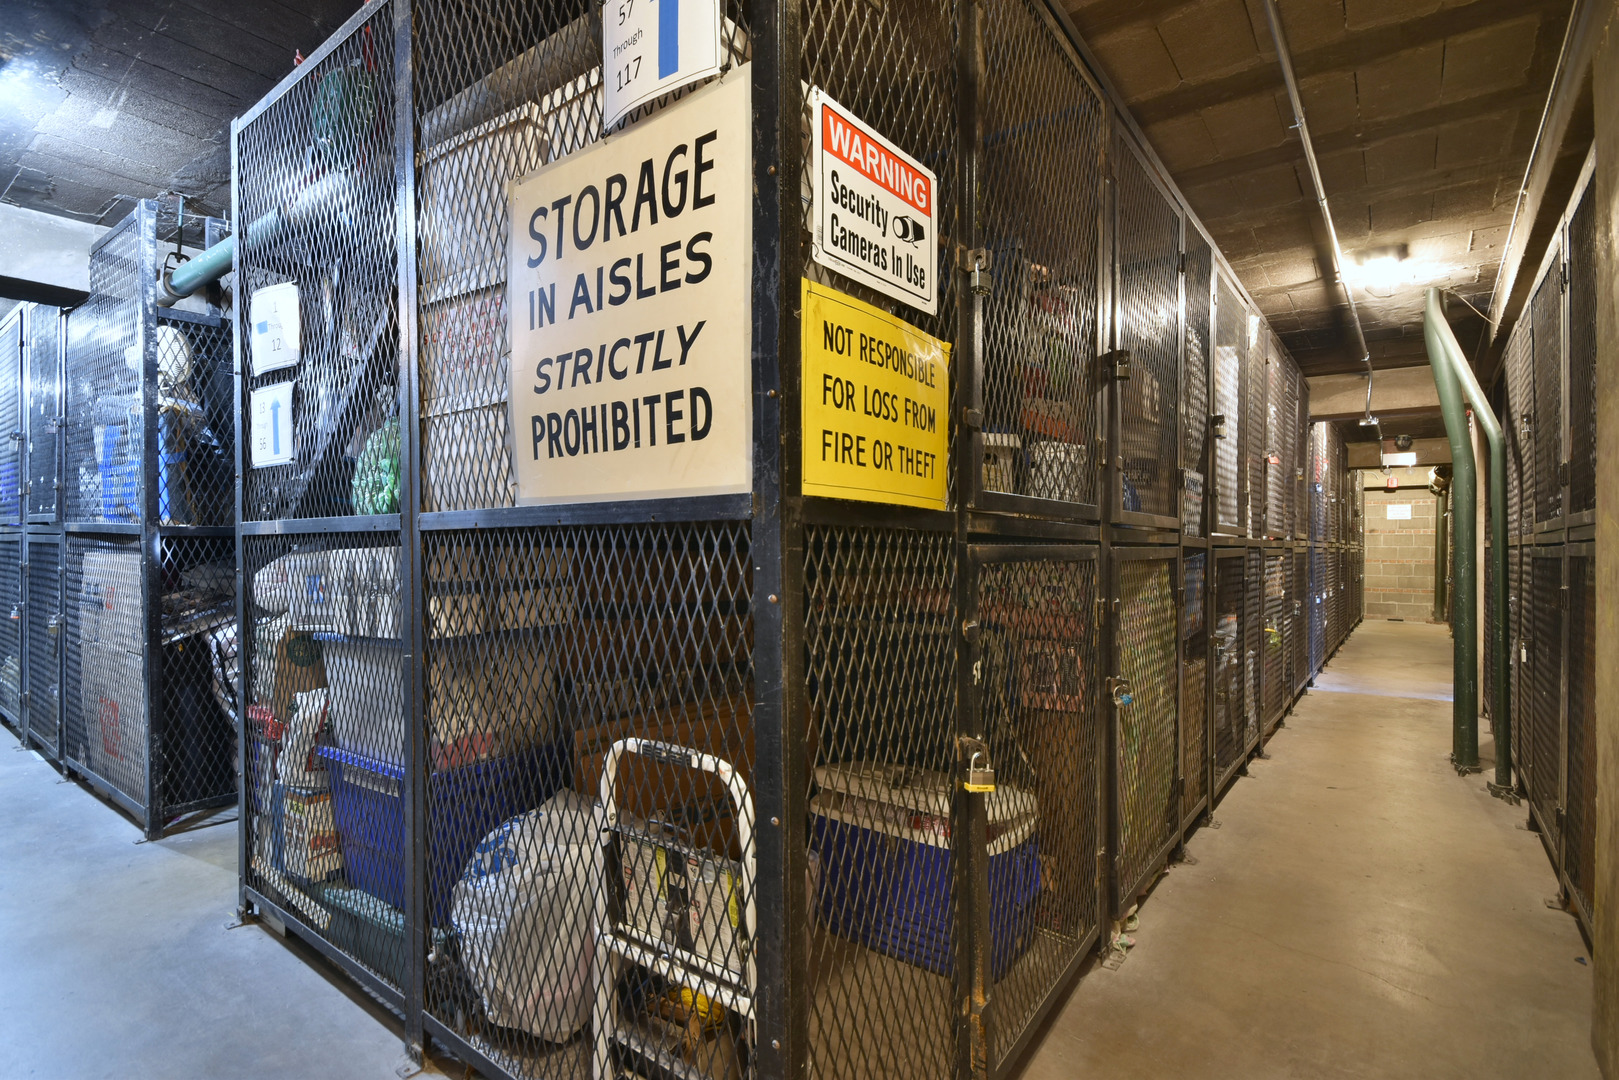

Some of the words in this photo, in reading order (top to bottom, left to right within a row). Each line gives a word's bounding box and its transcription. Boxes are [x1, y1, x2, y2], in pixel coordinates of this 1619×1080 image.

[613, 28, 643, 59] Through
[619, 0, 634, 26] 57
[616, 56, 642, 93] 117
[828, 116, 926, 208] WARNING
[527, 130, 718, 269] STORAGE
[831, 170, 889, 238] Security
[529, 282, 557, 331] IN
[568, 231, 713, 320] AISLES
[830, 212, 888, 271] Cameras
[892, 245, 903, 279] In
[906, 252, 926, 290] Use
[272, 337, 282, 352] 12
[534, 320, 707, 396] STRICTLY
[823, 320, 854, 356] NOT
[860, 334, 936, 389] RESPONSIBLE
[531, 386, 714, 461] PROHIBITED
[822, 373, 856, 412] FOR
[863, 384, 898, 424] LOSS
[904, 396, 936, 434] FROM
[822, 429, 867, 468] FIRE
[873, 440, 894, 473] OR
[898, 445, 936, 480] THEFT
